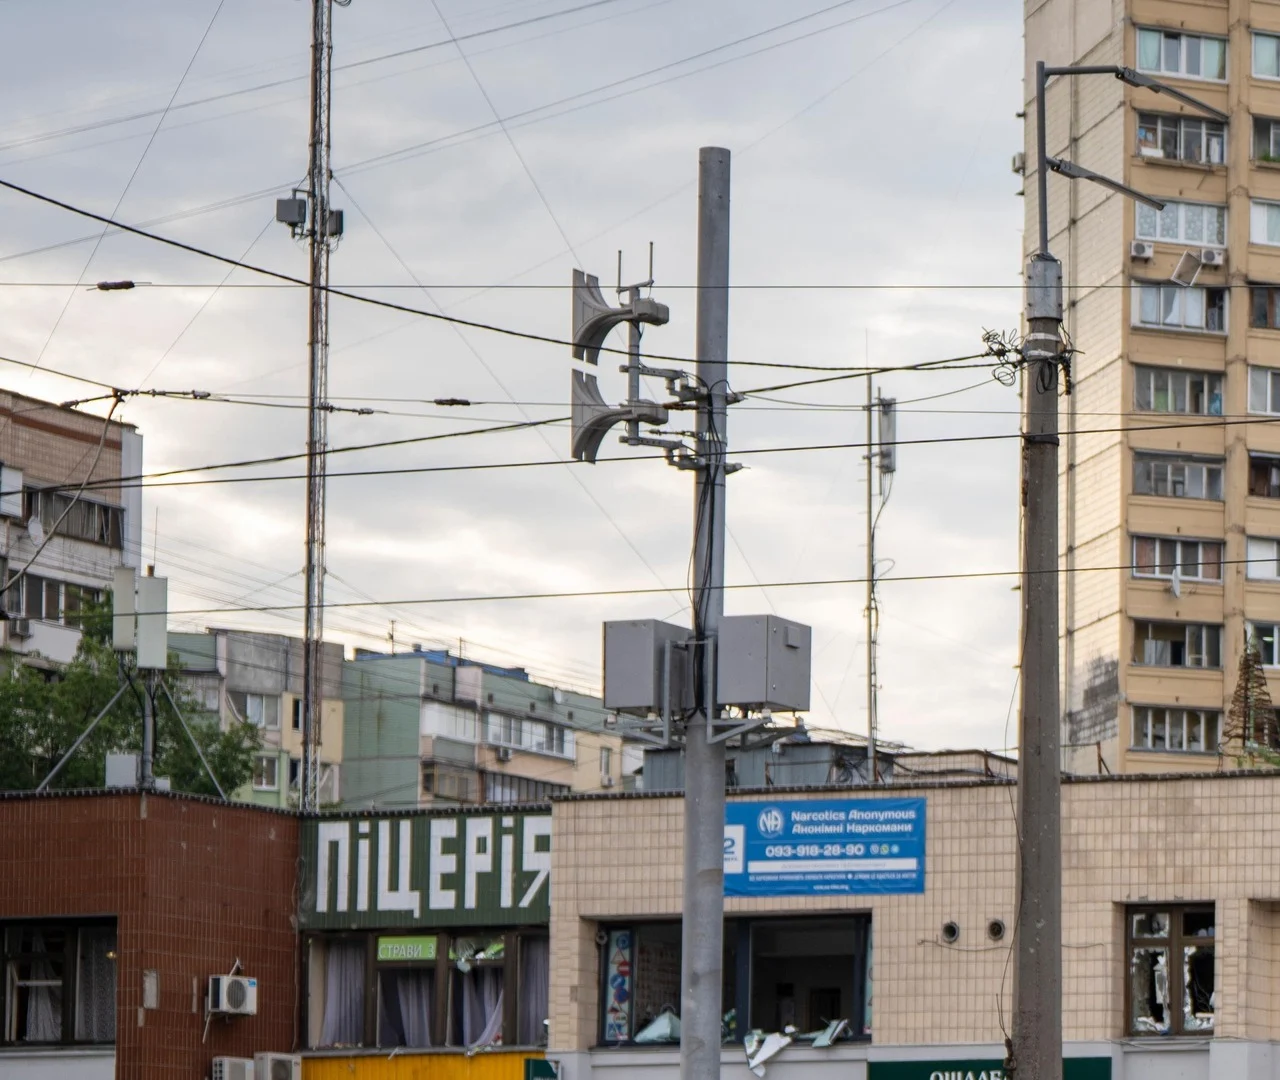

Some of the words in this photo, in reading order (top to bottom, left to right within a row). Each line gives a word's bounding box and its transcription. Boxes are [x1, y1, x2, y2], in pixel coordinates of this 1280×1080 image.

[791, 810, 845, 821] Narcotics
[848, 809, 915, 822] Anonymous
[792, 824, 843, 834] Анонімні
[846, 823, 912, 836] Наркомани
[765, 844, 864, 857] 093-918-28-90
[378, 945, 422, 958] СТРАВИ
